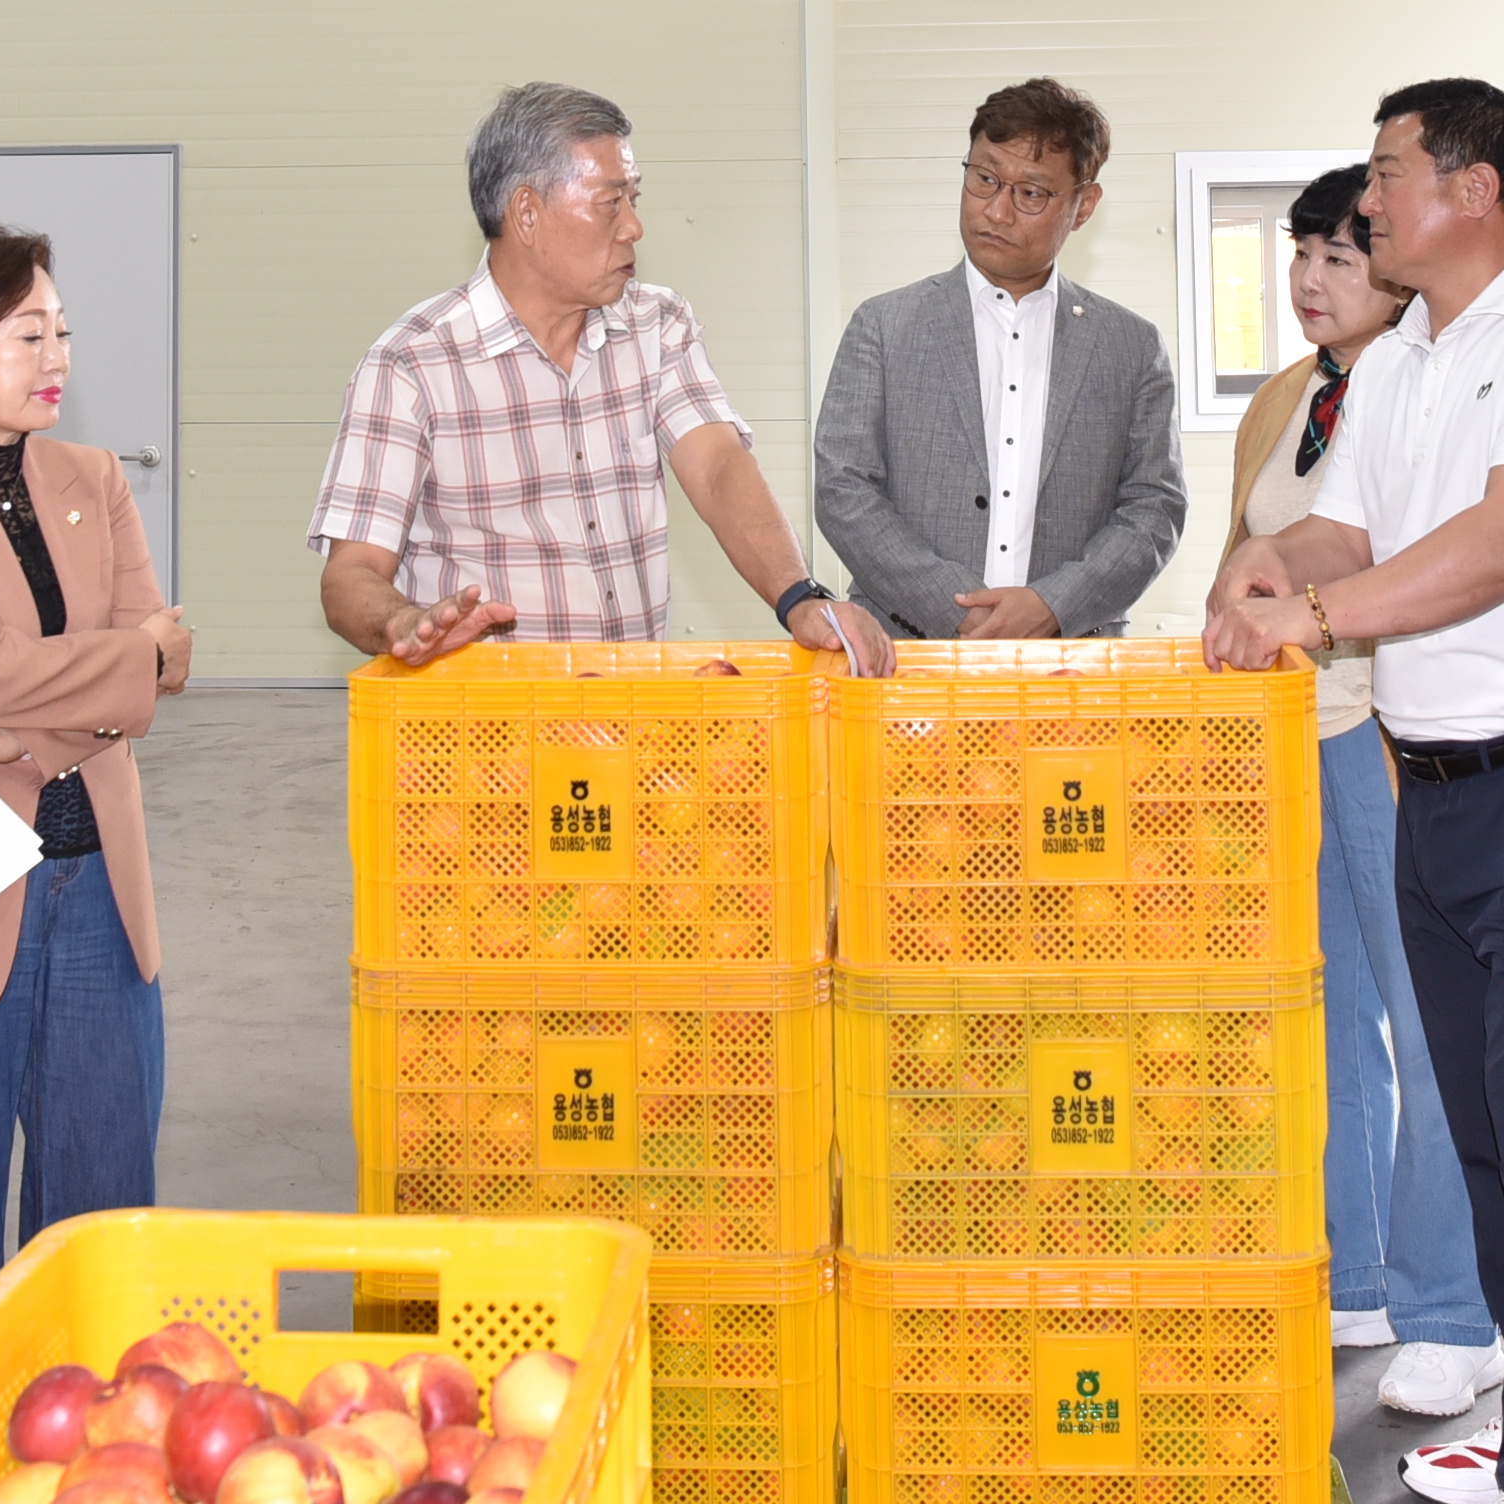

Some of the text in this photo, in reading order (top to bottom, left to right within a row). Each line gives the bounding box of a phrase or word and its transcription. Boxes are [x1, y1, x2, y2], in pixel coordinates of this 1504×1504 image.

[550, 804, 611, 834] 용성농협
[1042, 805, 1104, 835] 용성농협
[550, 836, 611, 852] 053)852-1922
[1042, 837, 1105, 853] 053)852-1922
[554, 1093, 614, 1122] 용성농협
[1052, 1095, 1114, 1124] 용성농협
[553, 1125, 614, 1141] 053)852-1922
[1052, 1127, 1114, 1144] 053)852-1922
[1057, 1399, 1119, 1422] 용성농협
